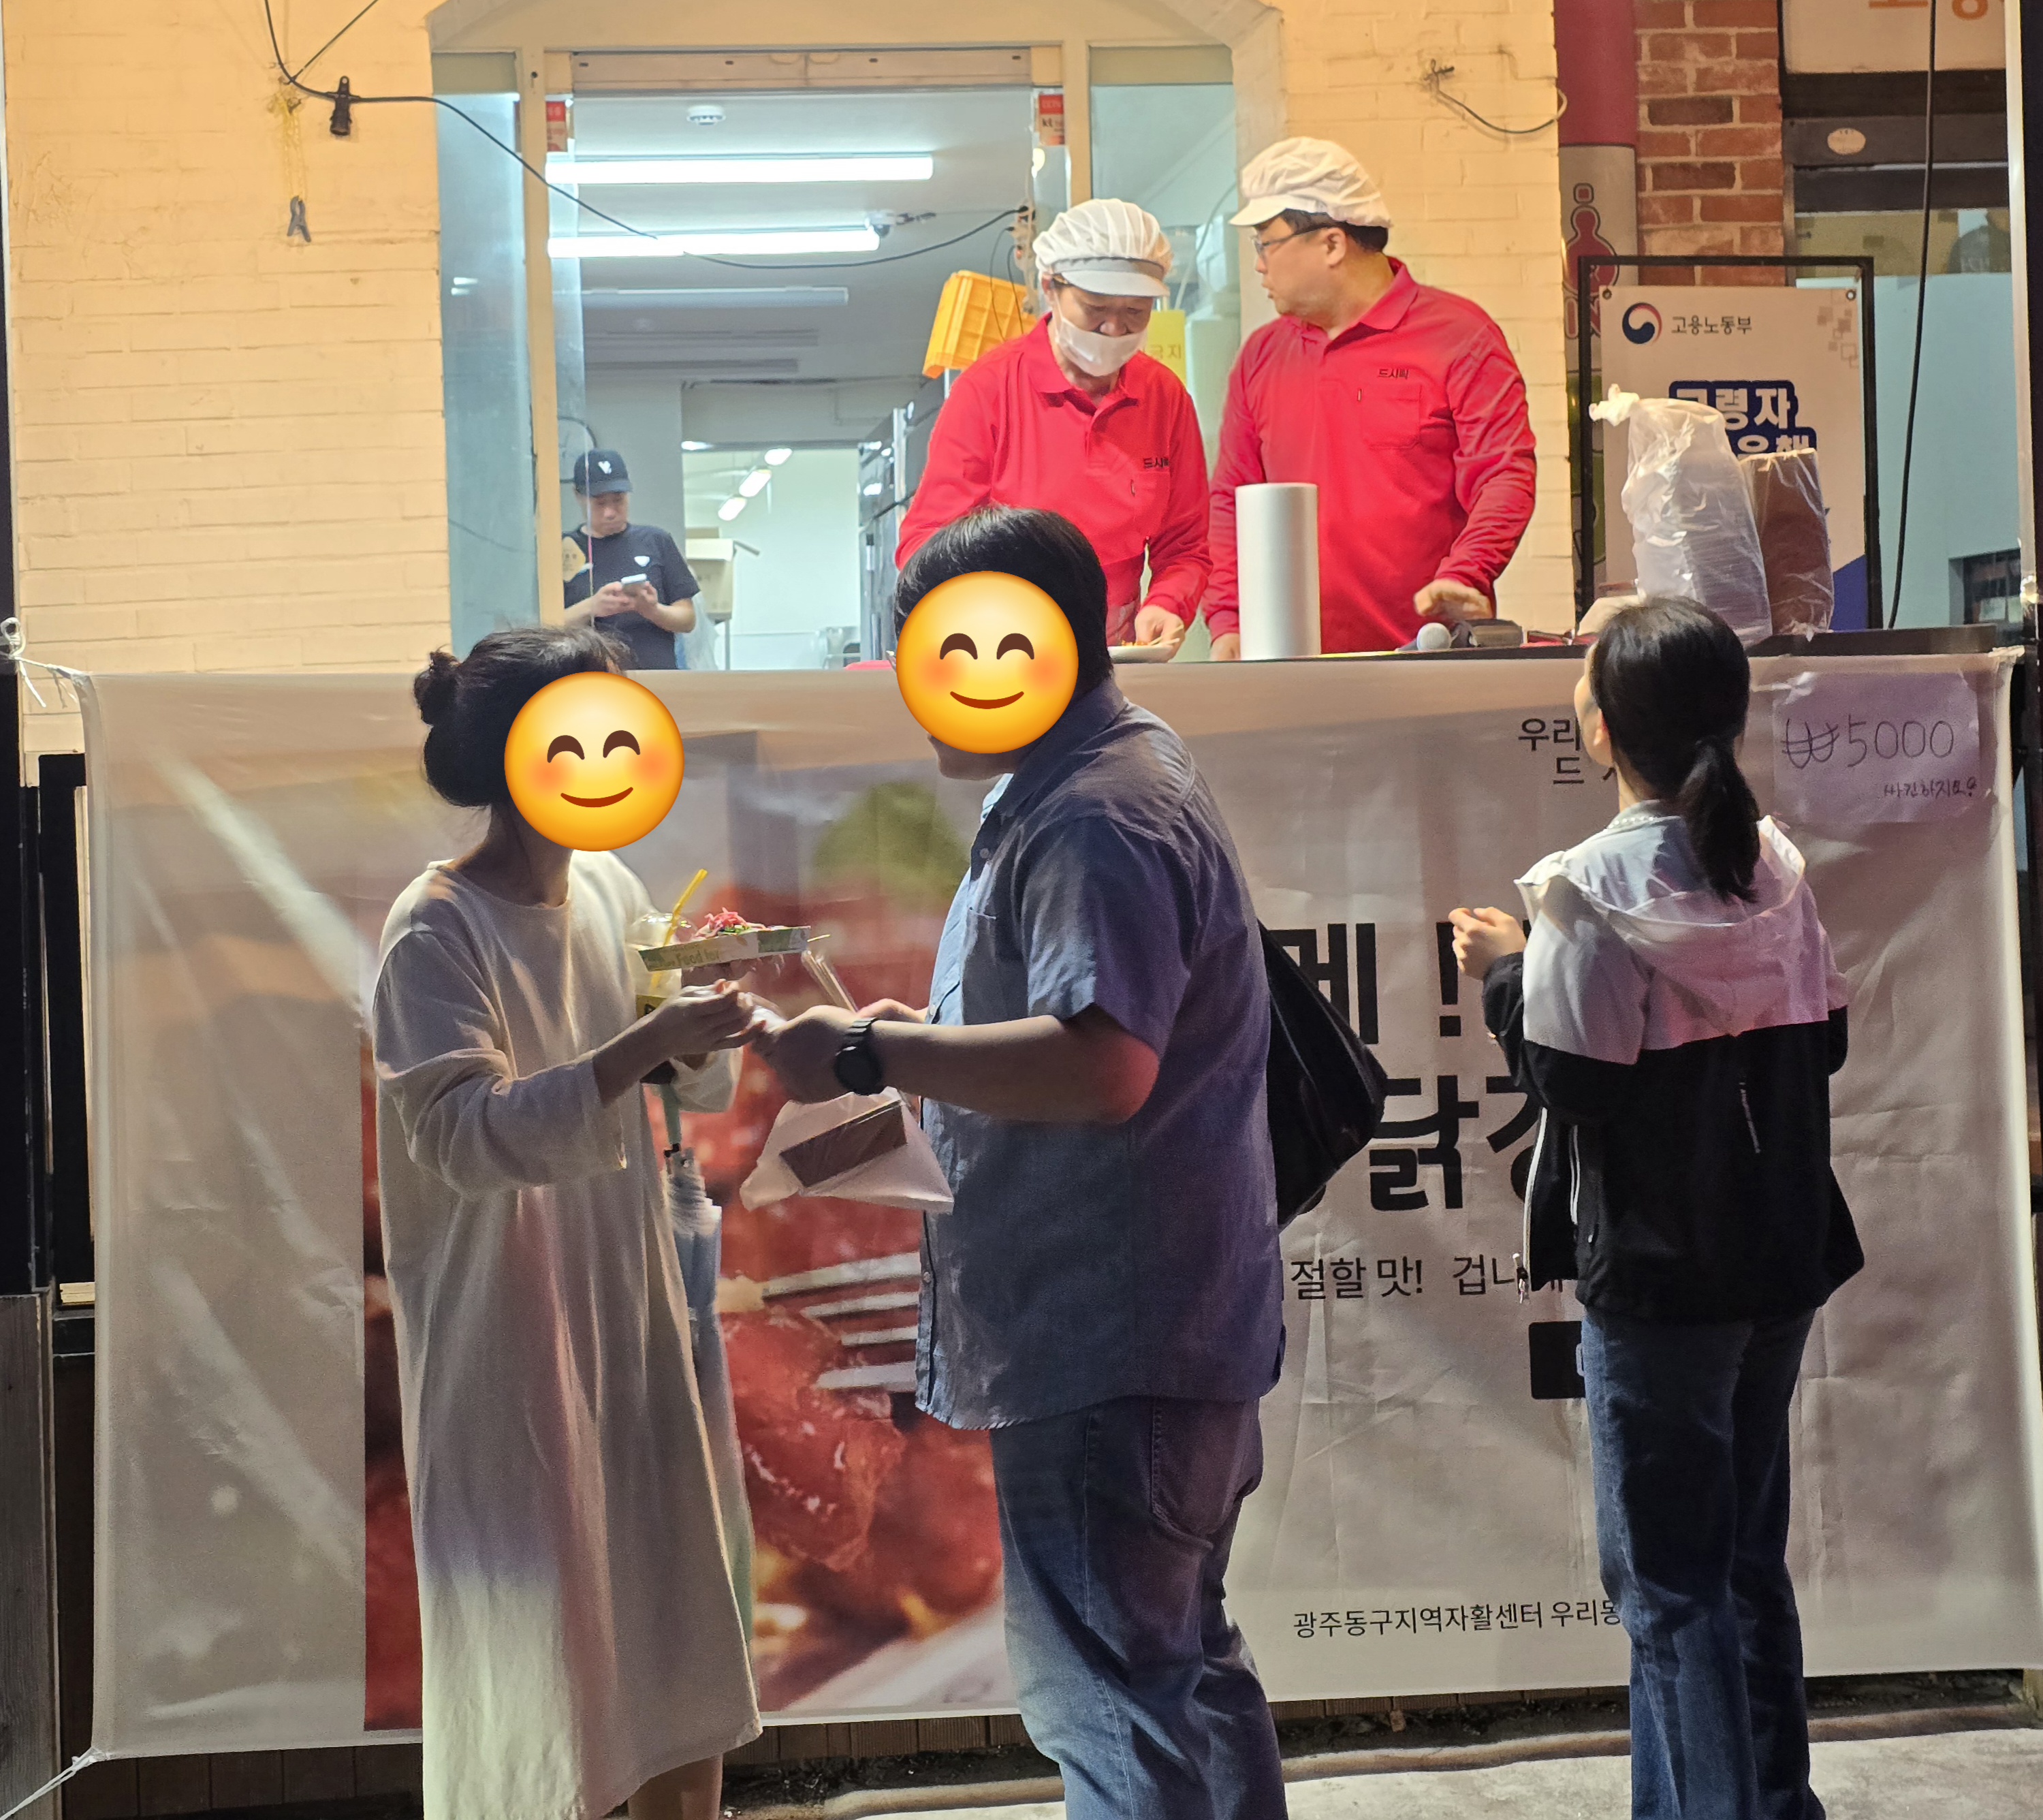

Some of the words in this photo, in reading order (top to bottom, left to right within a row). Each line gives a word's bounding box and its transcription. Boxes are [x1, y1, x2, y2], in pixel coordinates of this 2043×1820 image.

[1671, 315, 1752, 336] 고용노동부
[1377, 1256, 1423, 1298] 맛!
[1293, 1601, 1542, 1638] 광주동구지역자활센터
